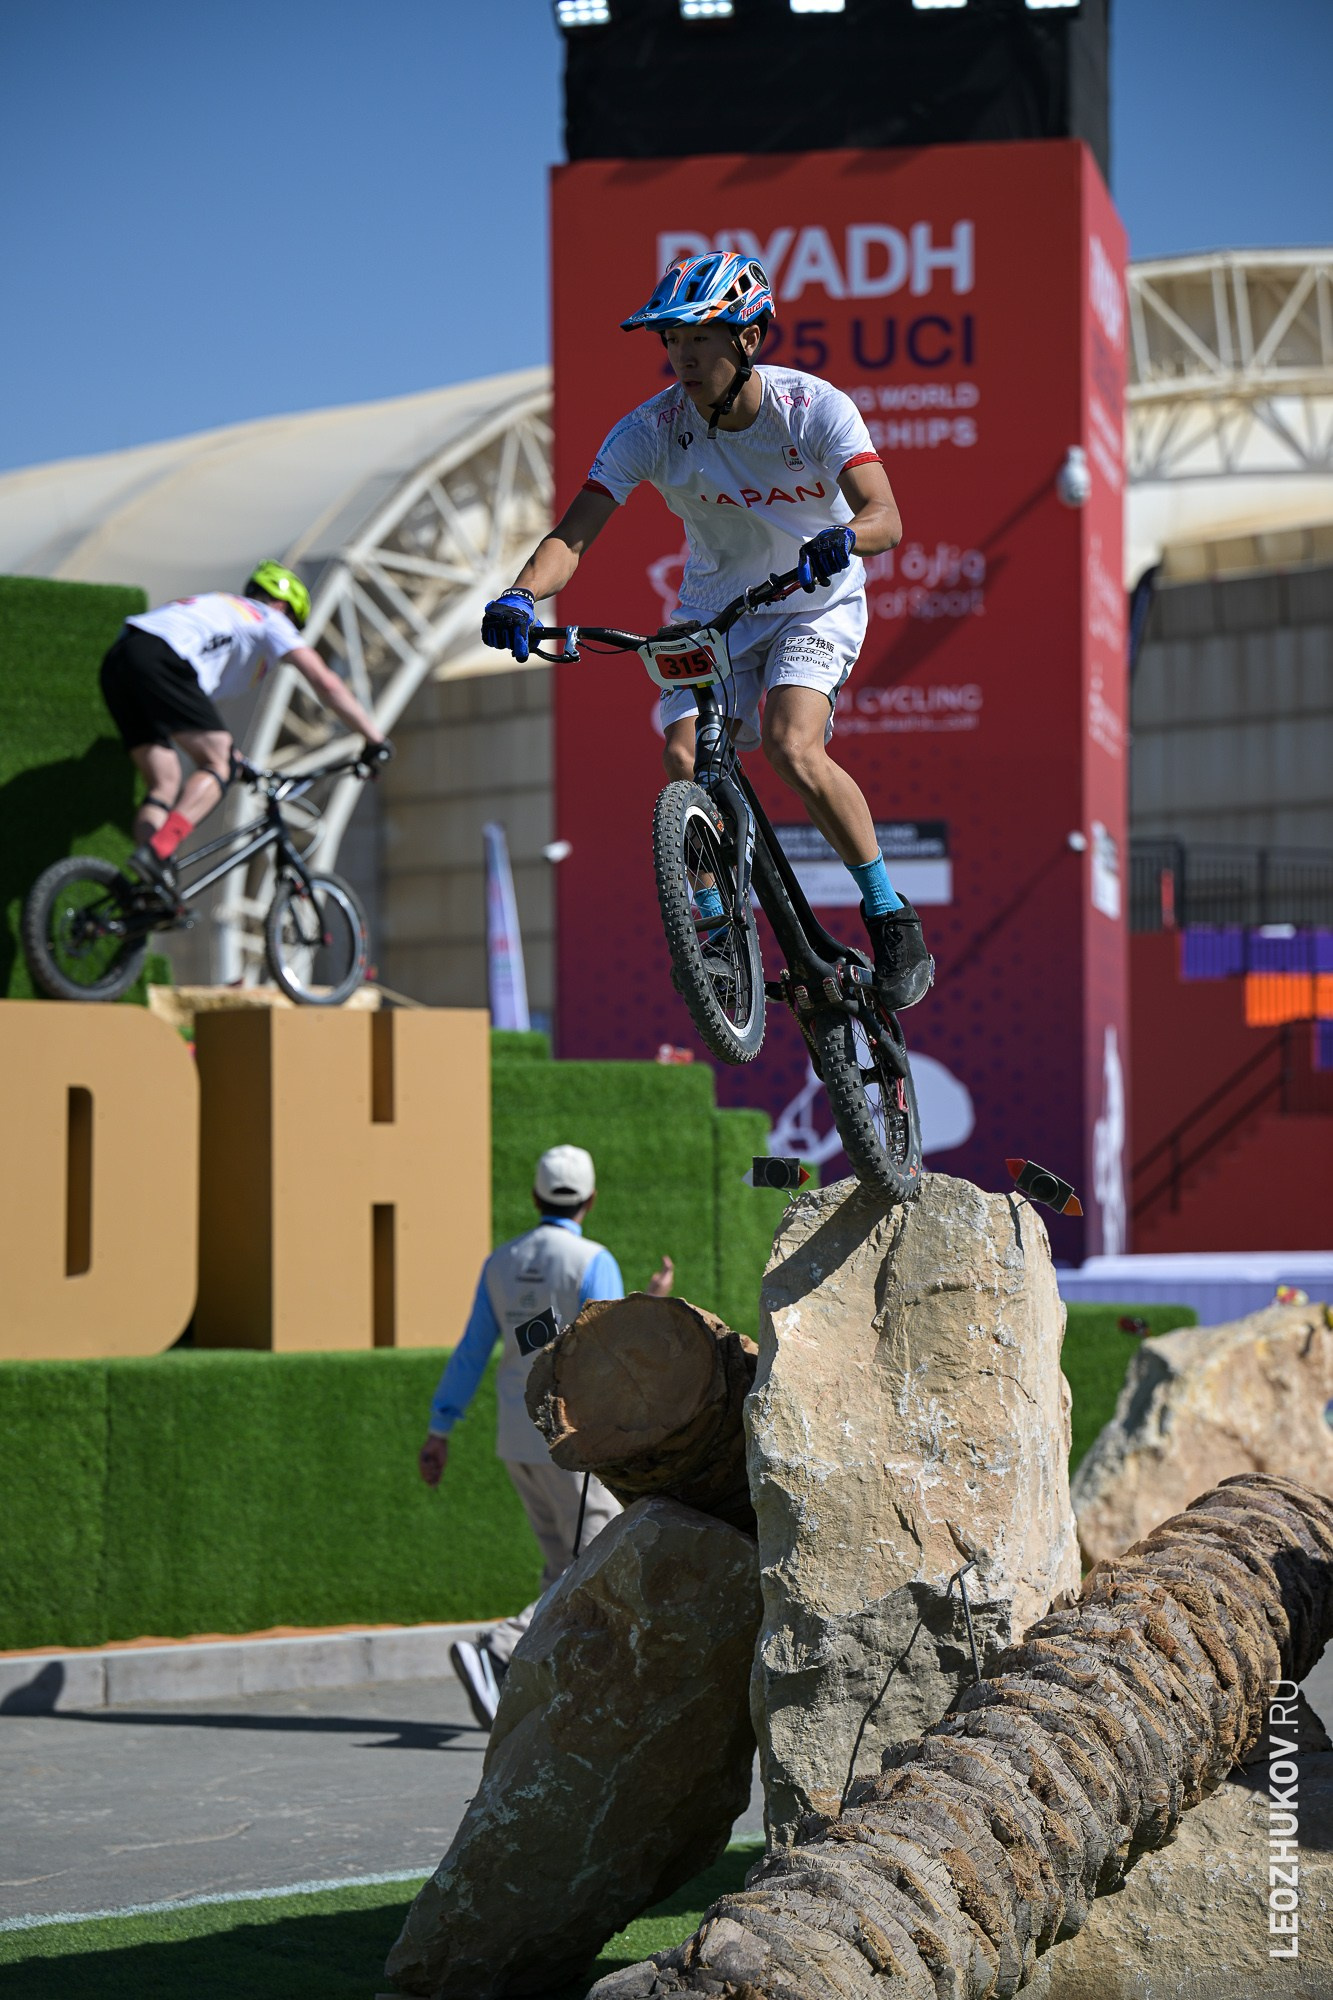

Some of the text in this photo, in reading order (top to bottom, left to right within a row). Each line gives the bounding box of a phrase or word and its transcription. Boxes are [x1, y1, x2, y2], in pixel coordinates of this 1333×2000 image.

[851, 314, 974, 371] UCI
[877, 383, 980, 411] WORLD
[664, 652, 709, 676] 315
[855, 682, 984, 714] CYCLING
